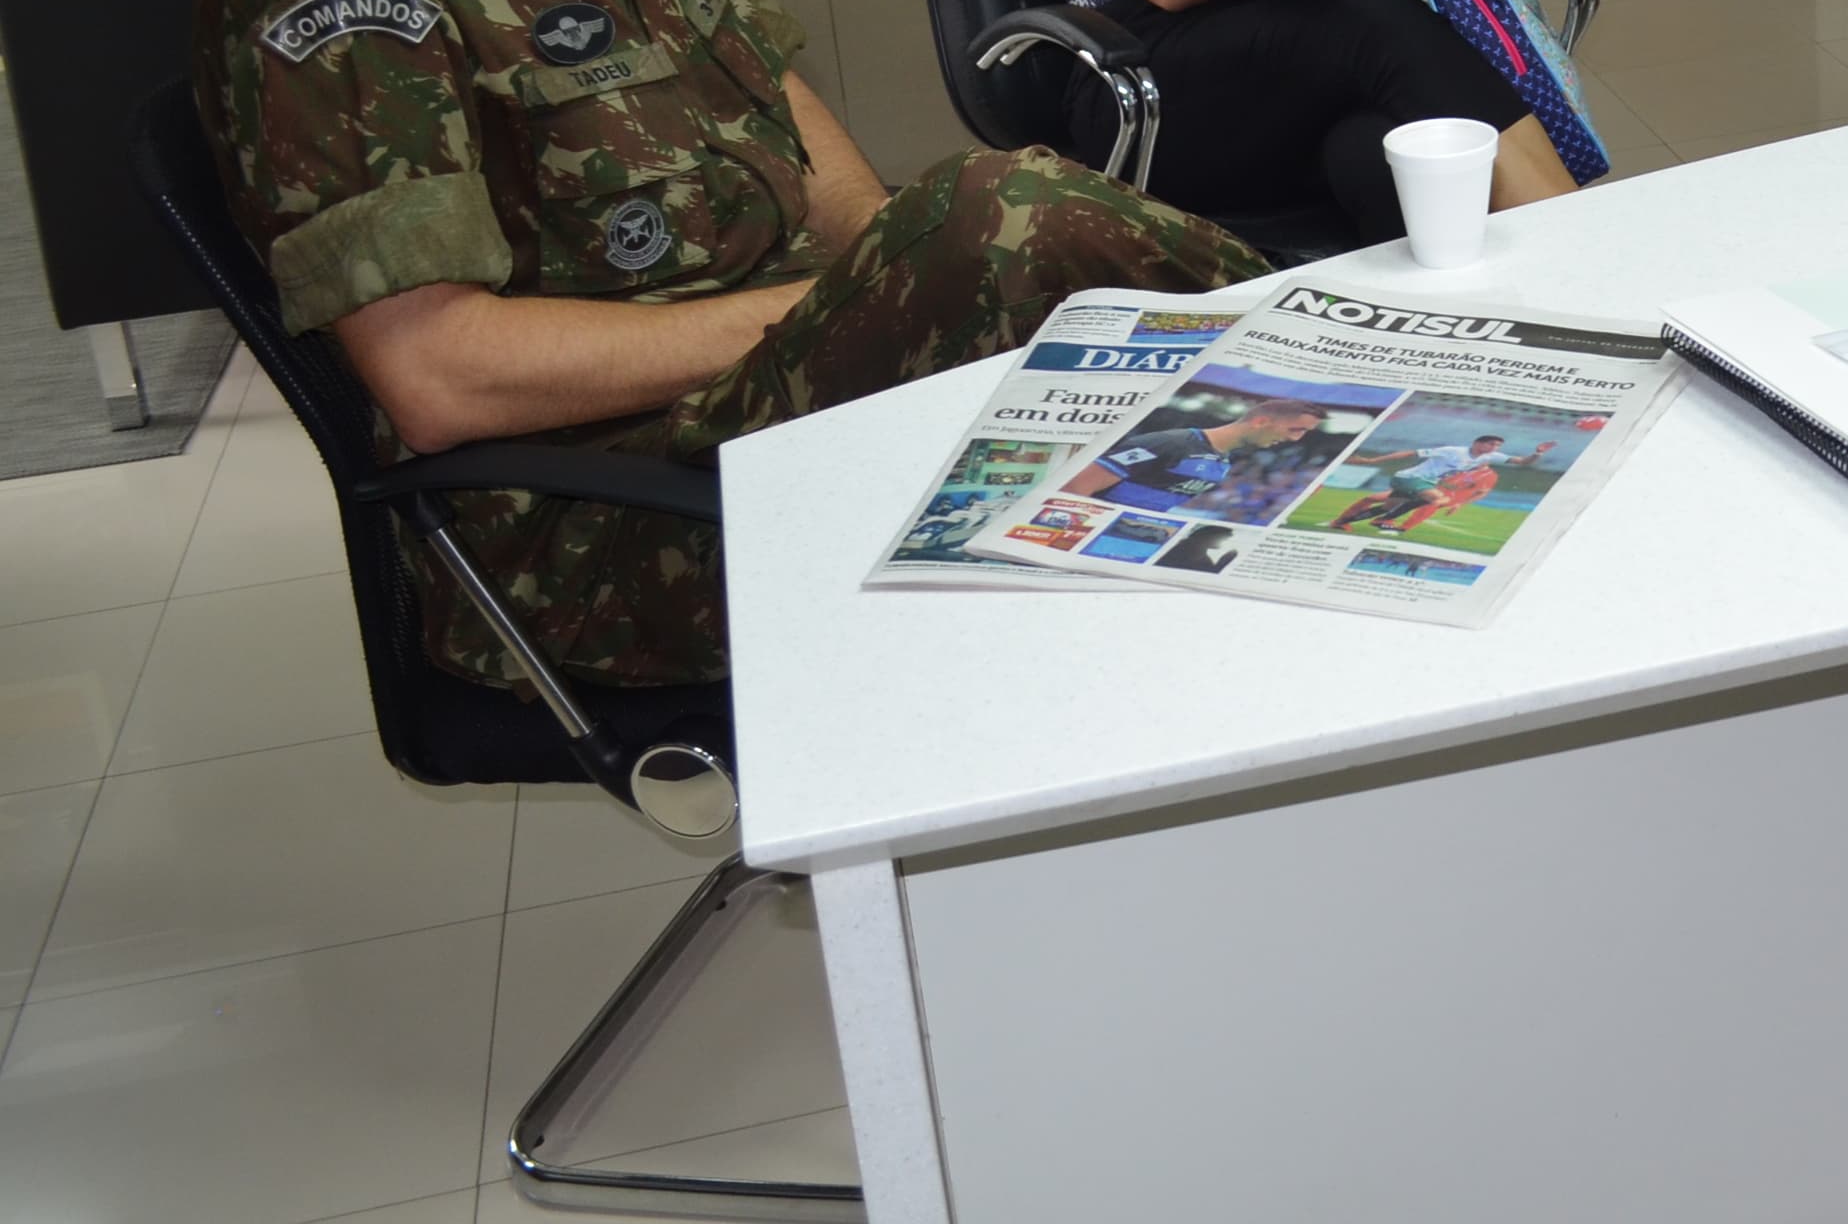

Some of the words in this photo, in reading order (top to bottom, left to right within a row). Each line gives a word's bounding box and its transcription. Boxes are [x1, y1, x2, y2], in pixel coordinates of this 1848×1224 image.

[568, 62, 631, 87] TADEU
[1281, 289, 1522, 344] NOTISUL
[1244, 330, 1386, 364] REBAIXAMENTO
[1387, 356, 1427, 368] FICA
[1431, 361, 1482, 373] CADA
[1487, 366, 1521, 377] VEZ
[1523, 371, 1570, 385] MAIS
[1572, 377, 1635, 391] PERTO
[1316, 335, 1370, 352] TIMES
[1370, 343, 1398, 355] DE
[1399, 347, 1485, 363] TUBARÃO
[1488, 357, 1563, 375] PERDEM
[1564, 367, 1580, 376] E
[994, 406, 1048, 421] em
